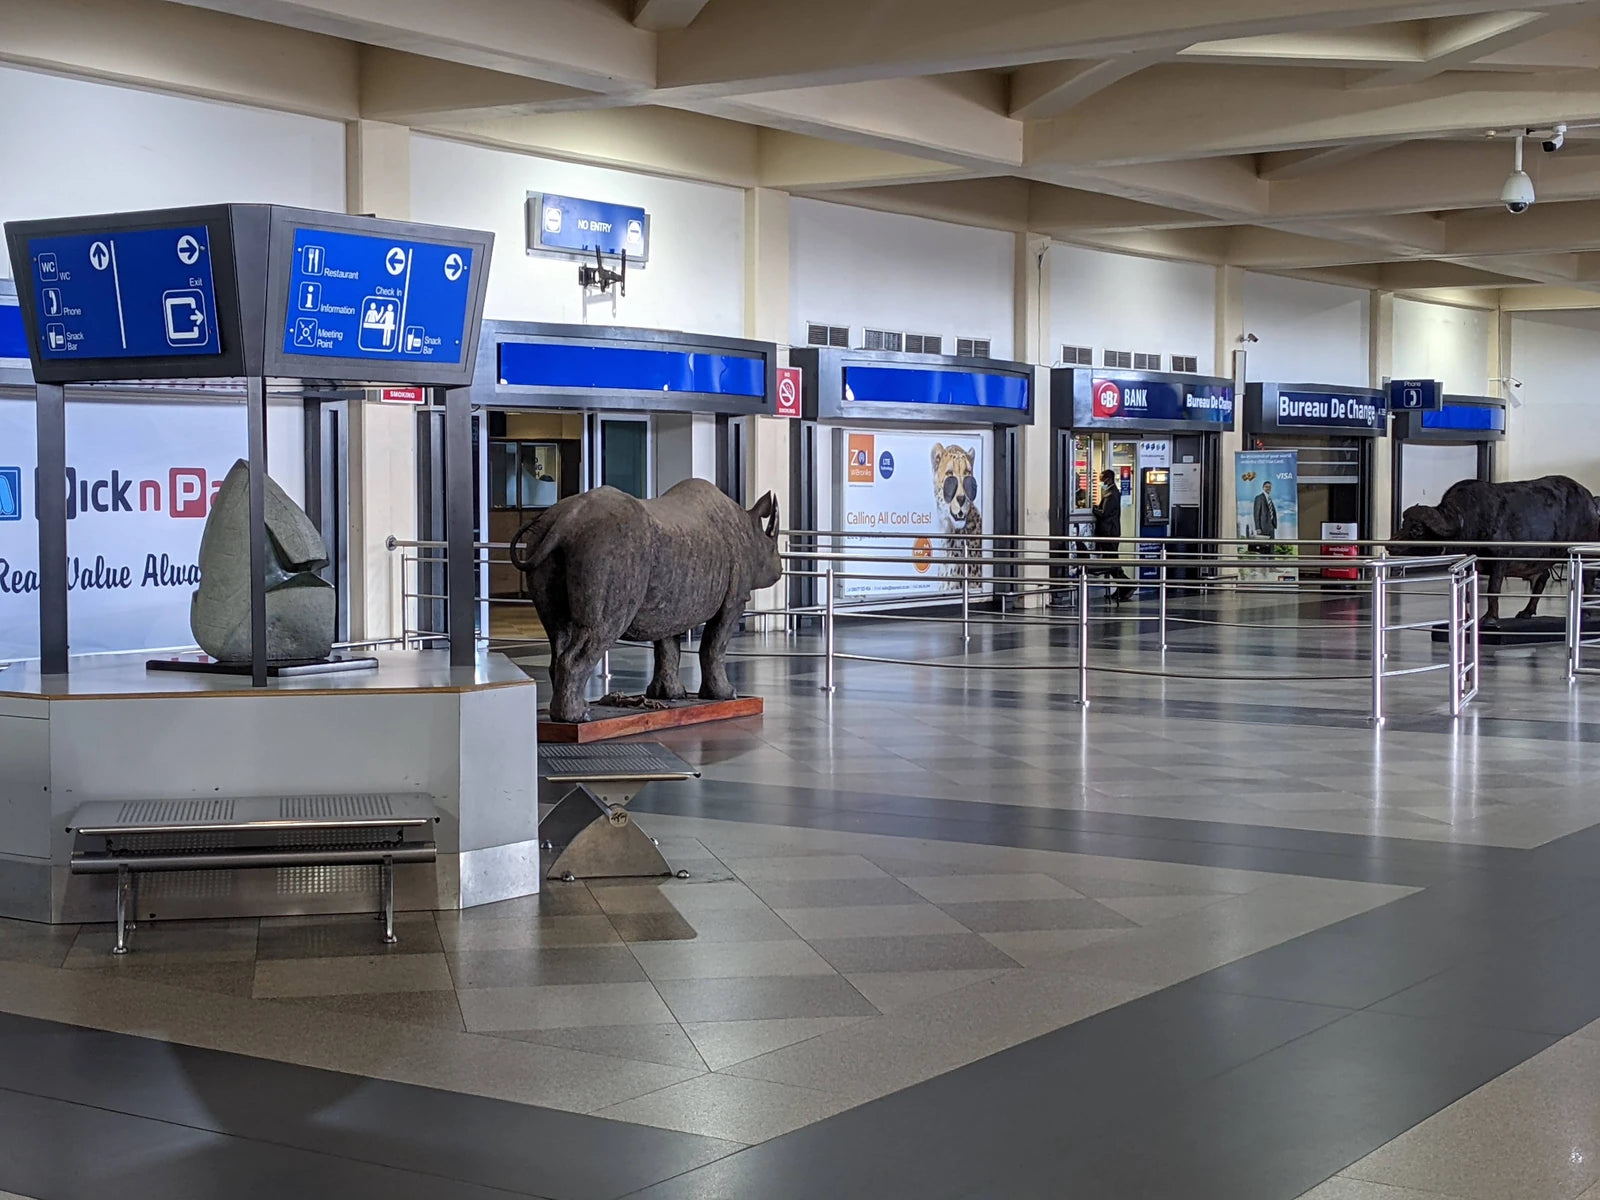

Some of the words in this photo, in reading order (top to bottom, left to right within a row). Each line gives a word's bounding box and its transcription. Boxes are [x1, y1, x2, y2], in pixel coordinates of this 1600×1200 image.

[577, 219, 589, 230] NO
[590, 220, 613, 233] ENTRY
[41, 261, 56, 273] WC
[59, 271, 71, 281] WC
[323, 267, 359, 280] Restaurant
[189, 277, 203, 287] Exit
[375, 285, 395, 296] Check
[396, 287, 403, 297] In
[63, 307, 82, 316] Phone
[320, 303, 356, 315] Information
[66, 331, 84, 341] Snack
[317, 328, 344, 340] Meeting
[424, 335, 442, 345] Snack
[67, 341, 78, 351] Bar
[316, 338, 333, 349] Point
[423, 345, 434, 355] Bar
[390, 390, 416, 399] SMOKING
[1100, 390, 1118, 408] CBZ
[1124, 388, 1148, 407] BANK
[1186, 393, 1210, 409] Bureau
[1210, 395, 1219, 409] De
[1218, 396, 1233, 413] Change
[1279, 396, 1329, 418] Bureau
[1330, 399, 1346, 418] De
[1347, 399, 1376, 426] Change
[1276, 472, 1293, 480] VISA
[139, 479, 161, 512] n
[847, 512, 876, 528] Calling
[878, 512, 889, 524] All
[890, 512, 909, 525] Cool
[911, 512, 932, 524] Cats!
[0, 558, 41, 594] Rea
[141, 553, 202, 587] Alwa
